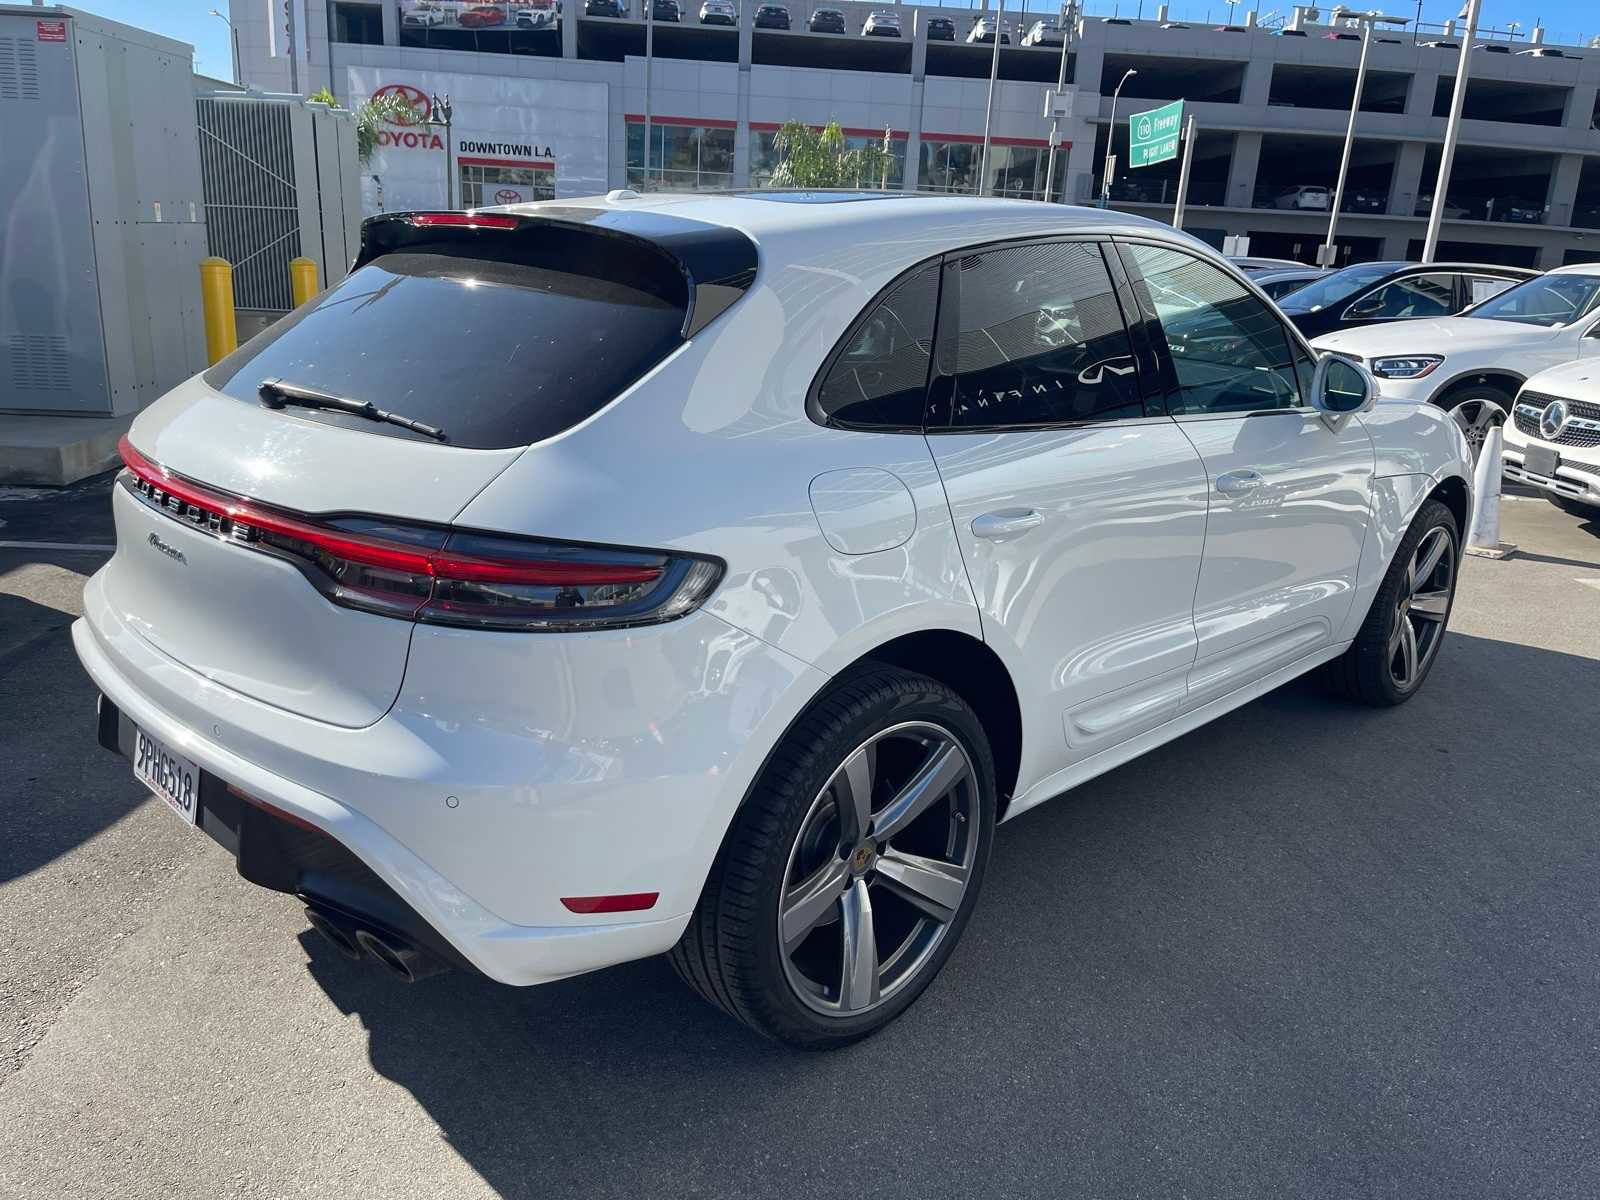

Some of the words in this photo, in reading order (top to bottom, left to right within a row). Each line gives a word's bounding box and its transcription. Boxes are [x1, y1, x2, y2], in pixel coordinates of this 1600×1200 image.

[1139, 123, 1150, 136] 110
[373, 130, 444, 150] OYOTA
[460, 141, 532, 156] DOWNTOWN
[535, 146, 556, 158] L.A.
[137, 733, 193, 812] 9PHG518
